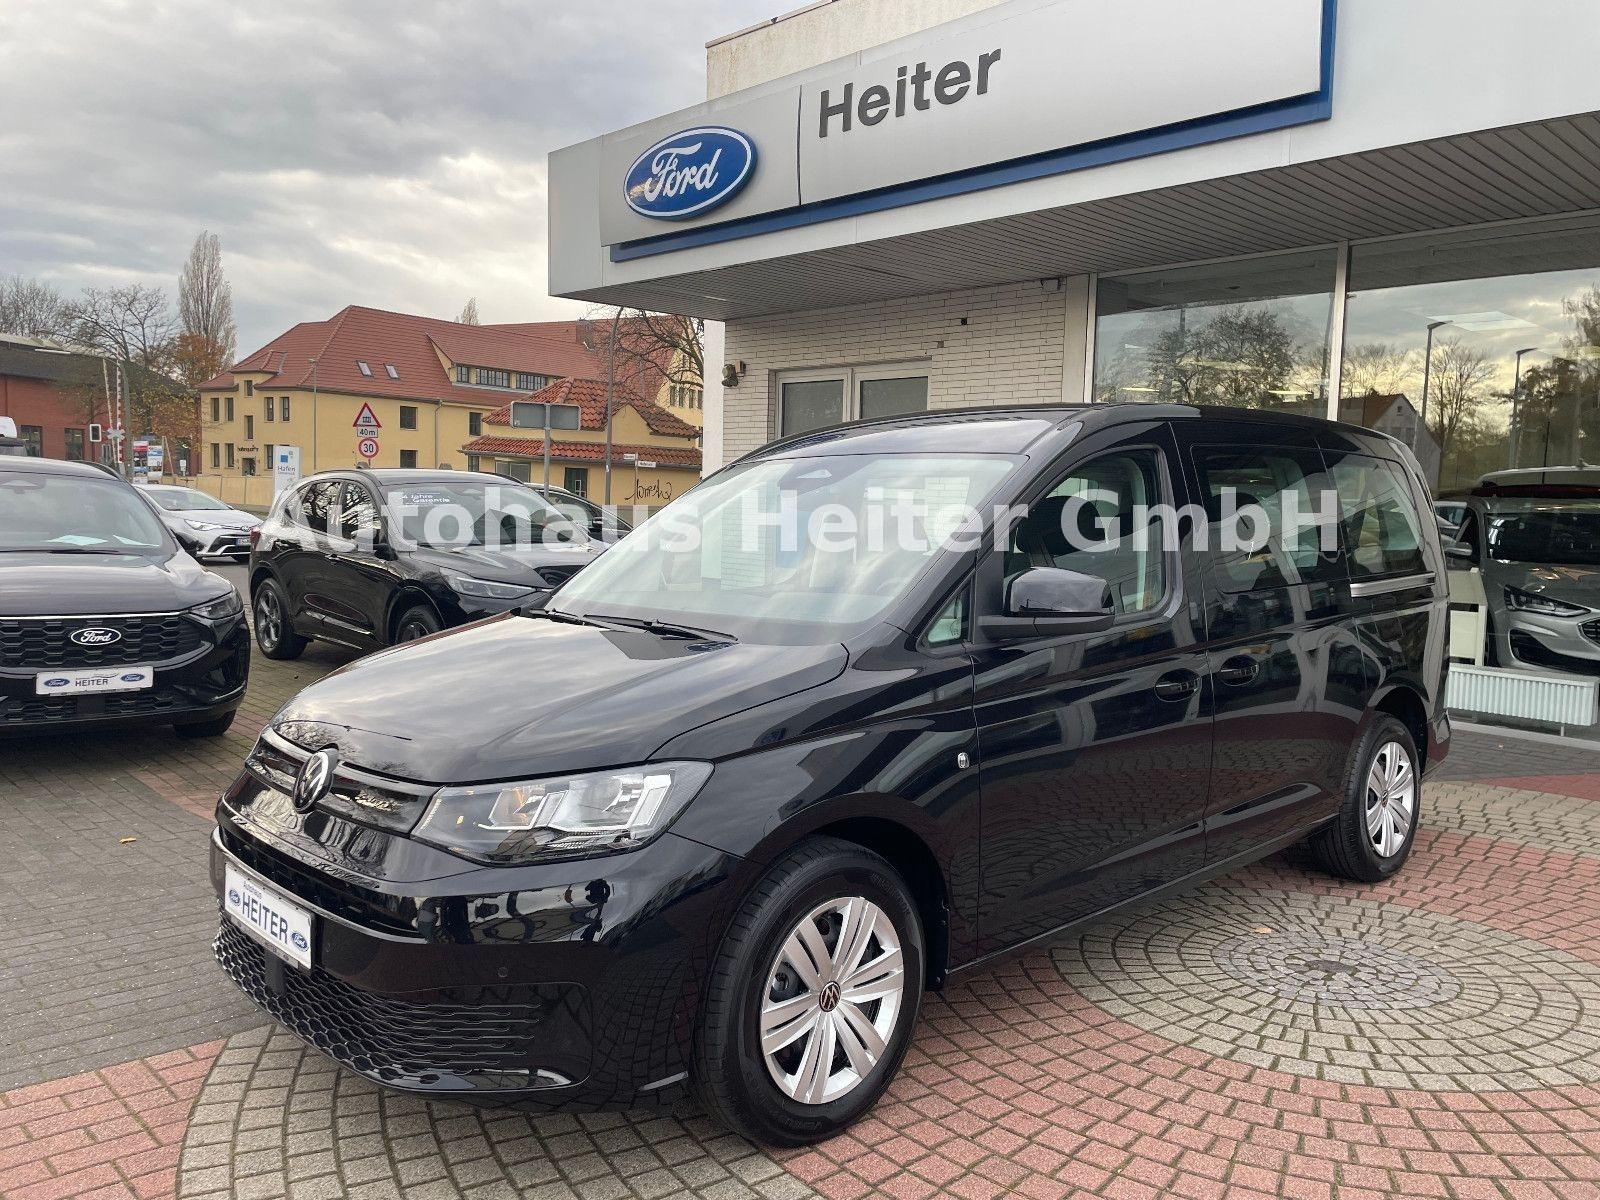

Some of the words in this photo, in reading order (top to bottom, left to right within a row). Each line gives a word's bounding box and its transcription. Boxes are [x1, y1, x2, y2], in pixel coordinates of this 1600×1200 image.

[818, 48, 1002, 138] Heiter
[644, 141, 723, 203] Ford
[363, 443, 374, 453] 30
[80, 630, 112, 643] Ford
[75, 679, 109, 687] HEITER
[242, 892, 288, 945] HEITER
